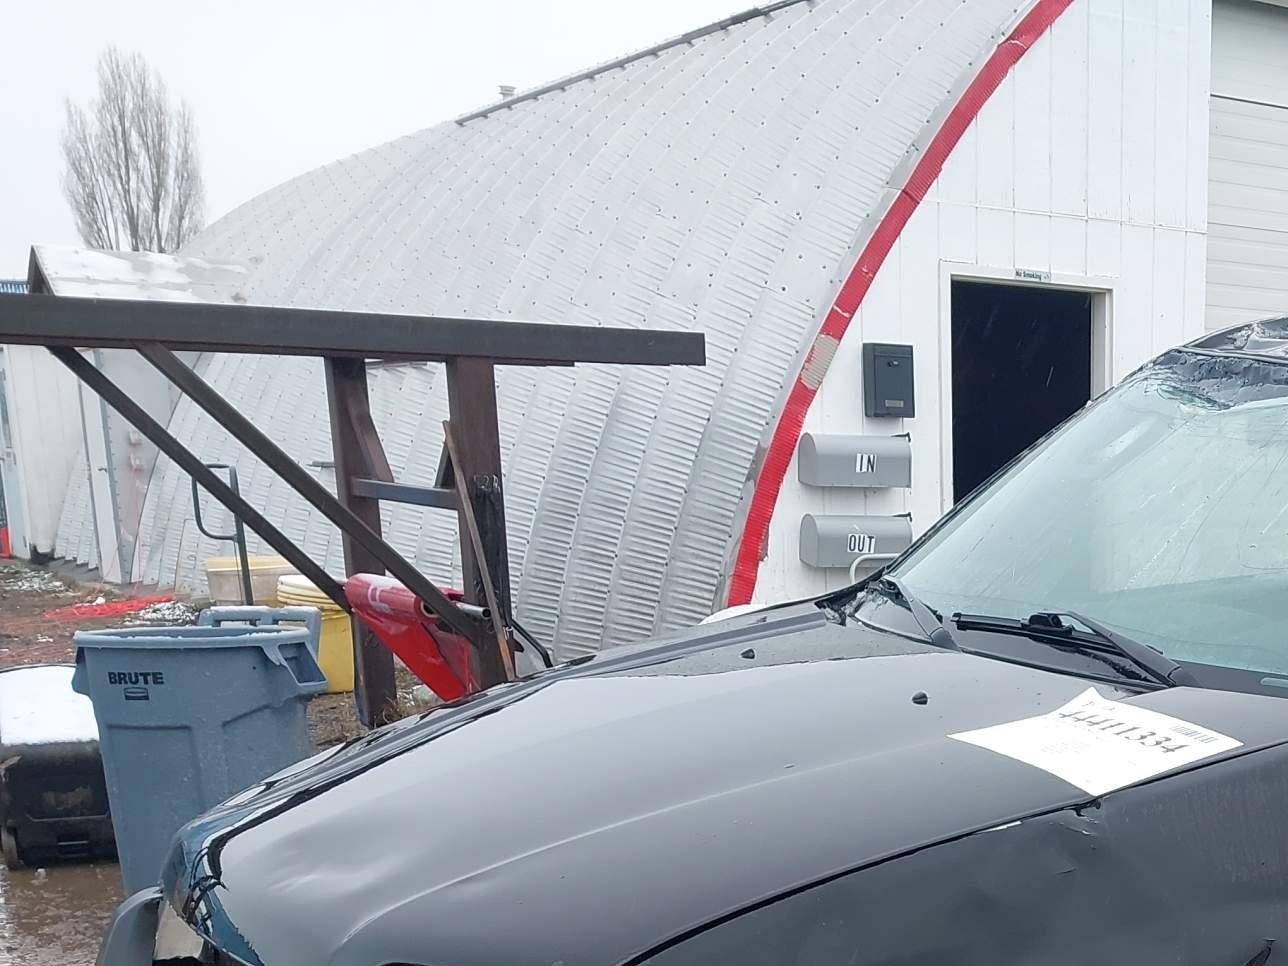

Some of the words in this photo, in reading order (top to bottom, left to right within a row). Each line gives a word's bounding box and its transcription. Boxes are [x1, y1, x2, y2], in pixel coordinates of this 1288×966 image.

[859, 454, 876, 472] IN
[848, 534, 875, 553] OUT
[107, 671, 165, 685] BRUTE
[1058, 710, 1190, 753] 44411334
